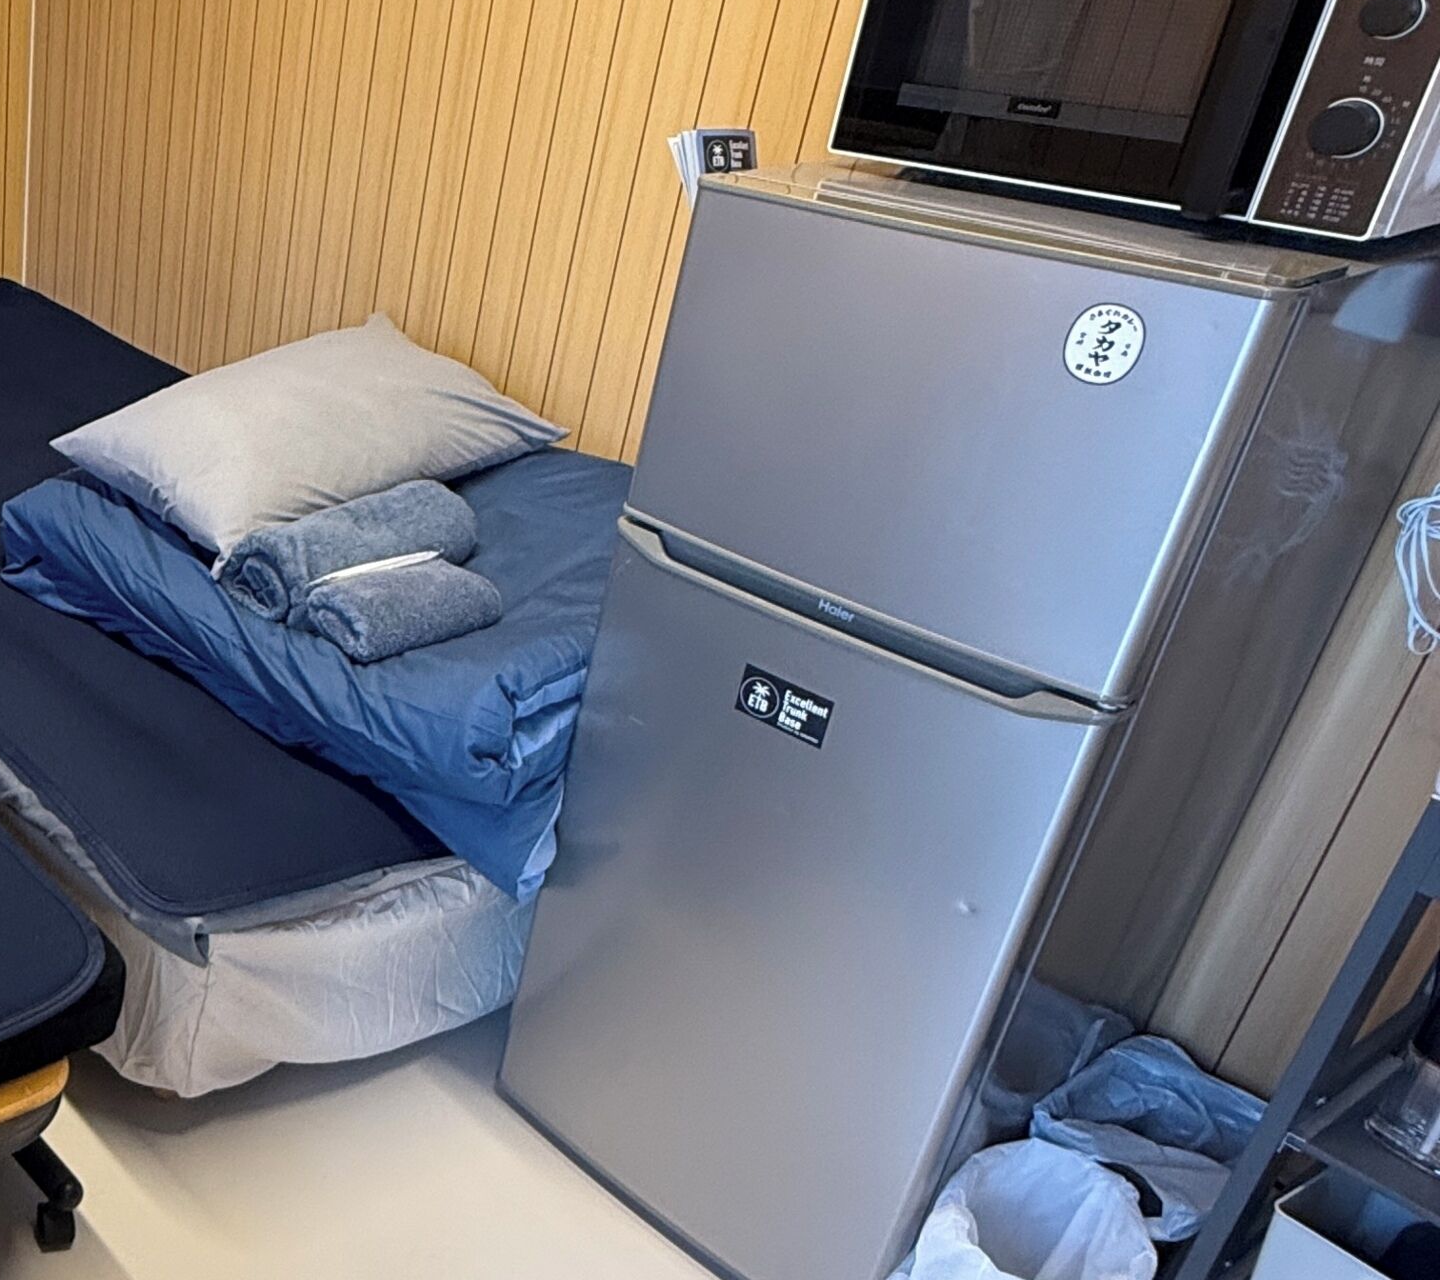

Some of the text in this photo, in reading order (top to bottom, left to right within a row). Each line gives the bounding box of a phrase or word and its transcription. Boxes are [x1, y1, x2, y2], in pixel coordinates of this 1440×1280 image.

[1088, 320, 1122, 367] タカヤ
[818, 599, 855, 623] Haier
[747, 693, 769, 713] ETB
[782, 700, 808, 722] Trunk
[784, 689, 829, 719] Excellent
[778, 711, 802, 730] Base
